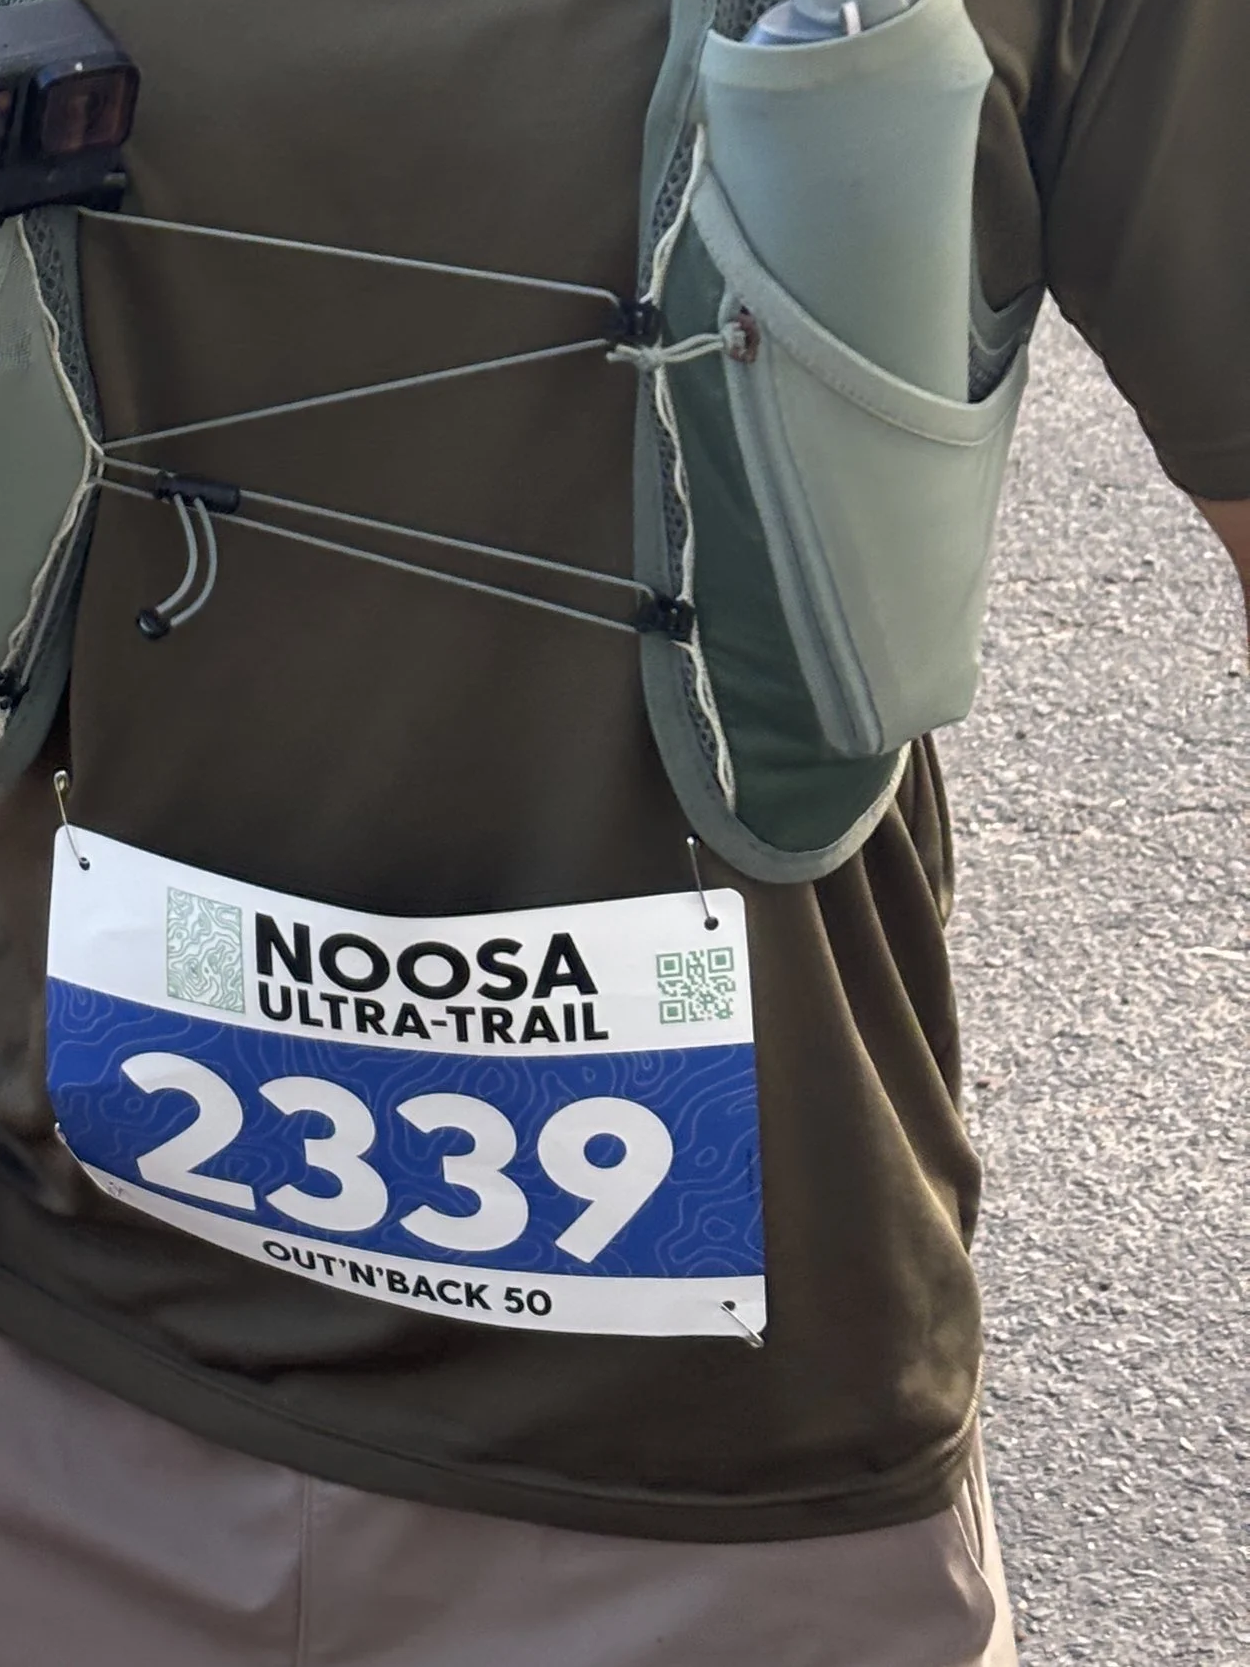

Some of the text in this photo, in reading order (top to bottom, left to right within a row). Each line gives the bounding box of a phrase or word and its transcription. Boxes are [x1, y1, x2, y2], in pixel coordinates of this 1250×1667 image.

[254, 912, 599, 1001] NOOSA
[258, 980, 610, 1044] ULTRA-TRAIL
[120, 1052, 674, 1264] 2339
[262, 1240, 553, 1316] OUT'N'BACK 50
